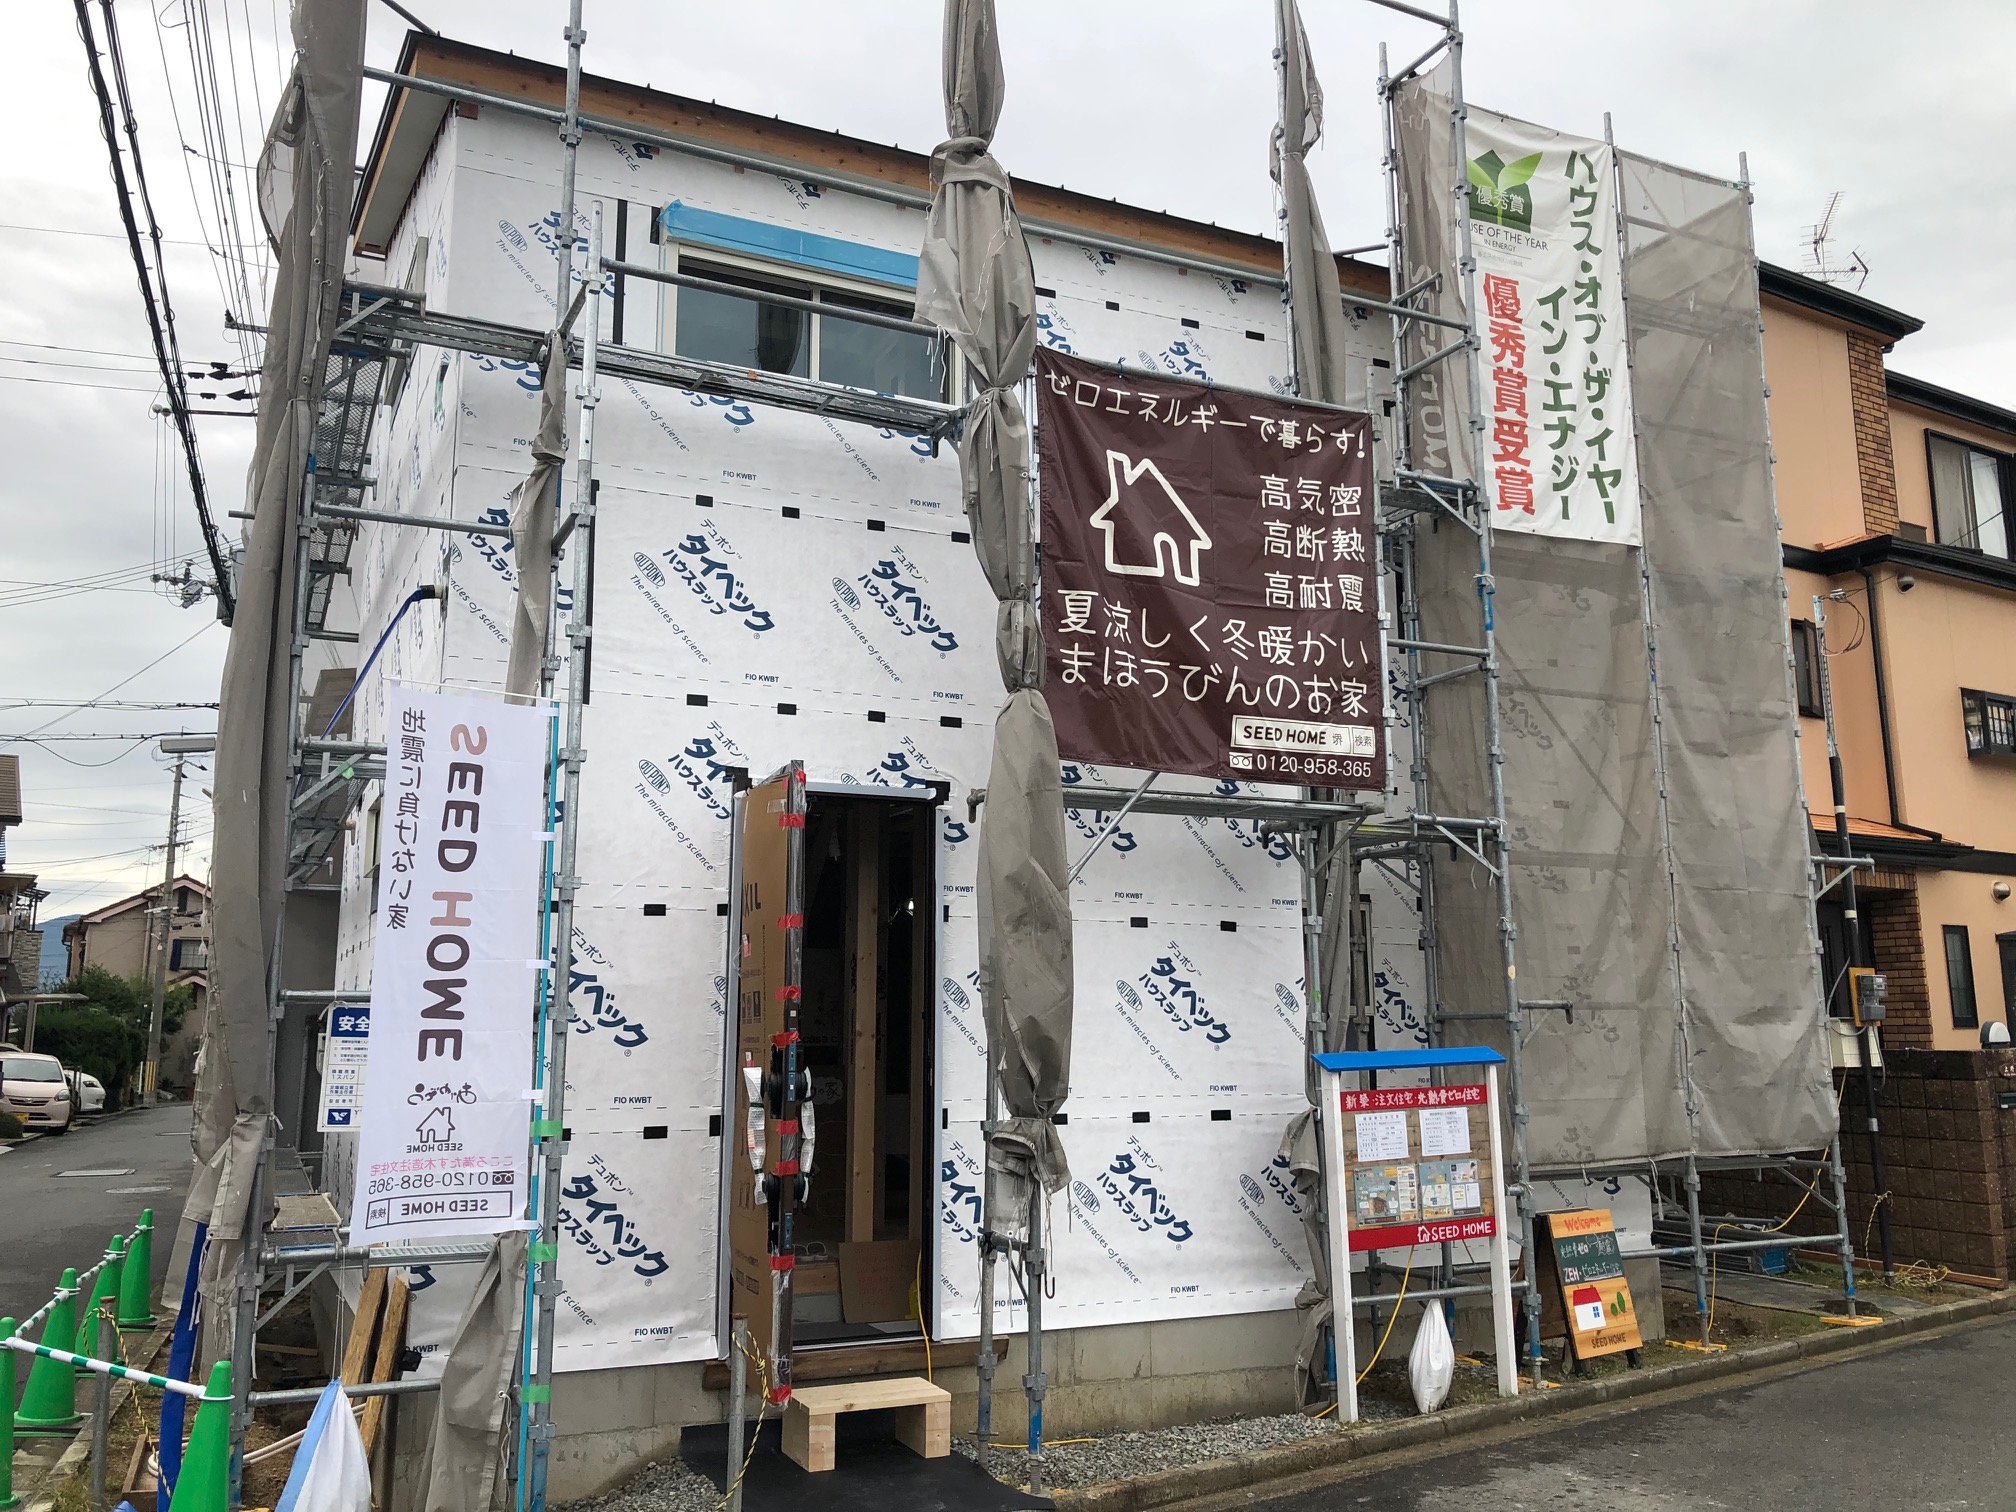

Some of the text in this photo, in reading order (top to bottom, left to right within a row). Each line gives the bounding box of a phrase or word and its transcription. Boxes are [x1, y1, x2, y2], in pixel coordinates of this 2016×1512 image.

[1476, 184, 1524, 215] 優秀賞
[1487, 227, 1549, 251] OF THE YEAR
[1492, 241, 1516, 252] ENERGY
[507, 253, 536, 284] miracles
[1565, 149, 1623, 524] ハウス・オブ・ザ・イヤー
[1483, 272, 1536, 516] 優秀賞受賞
[1537, 285, 1579, 520] イン・エナジー
[513, 438, 527, 446] FIO
[723, 470, 757, 481] FIO KWBT
[1260, 474, 1362, 516] 高気密
[922, 501, 941, 509] KWBT
[1264, 519, 1365, 562] 高断熱
[630, 574, 645, 590] The
[643, 590, 673, 624] miracles
[662, 549, 727, 614] ハウスラップ
[678, 534, 775, 631] タイベック
[1264, 571, 1365, 613] 高耐震
[830, 598, 843, 614] The
[841, 613, 868, 644] miracles
[857, 574, 916, 636] ハウスラップ
[871, 560, 959, 651] タイベック
[479, 613, 508, 643] science
[745, 673, 779, 683] FIO KWBT
[1059, 642, 1368, 718] まほうびんのお家
[1243, 726, 1343, 746] SEED HOME 堺
[1355, 735, 1372, 747] 検索
[1257, 754, 1371, 777] 0120-958-365
[635, 783, 650, 799] The
[647, 799, 678, 832] miracles
[1182, 817, 1193, 830] The
[1192, 830, 1215, 859] miracles
[1138, 973, 1192, 1031] ハウスラップ
[1150, 957, 1231, 1043] タイベック
[951, 1015, 977, 1046] miracles
[1114, 1002, 1126, 1017] The
[1125, 1015, 1150, 1045] miracles
[1097, 1172, 1152, 1231] ハウスラップ
[1109, 1153, 1193, 1242] タイベック
[1238, 1196, 1249, 1211] The
[1249, 1210, 1272, 1239] miracles
[562, 1175, 669, 1277] タイベック
[1071, 1204, 1083, 1219] The
[1082, 1218, 1108, 1249] miracles
[1431, 1221, 1492, 1241] SEED HOME
[1563, 1217, 1601, 1232] Welcome
[1171, 1285, 1199, 1294] FIO KWBT
[414, 1344, 439, 1353] KWBT
[635, 1327, 673, 1336] FIO KWBT
[1591, 1332, 1627, 1349] SEED HOME
